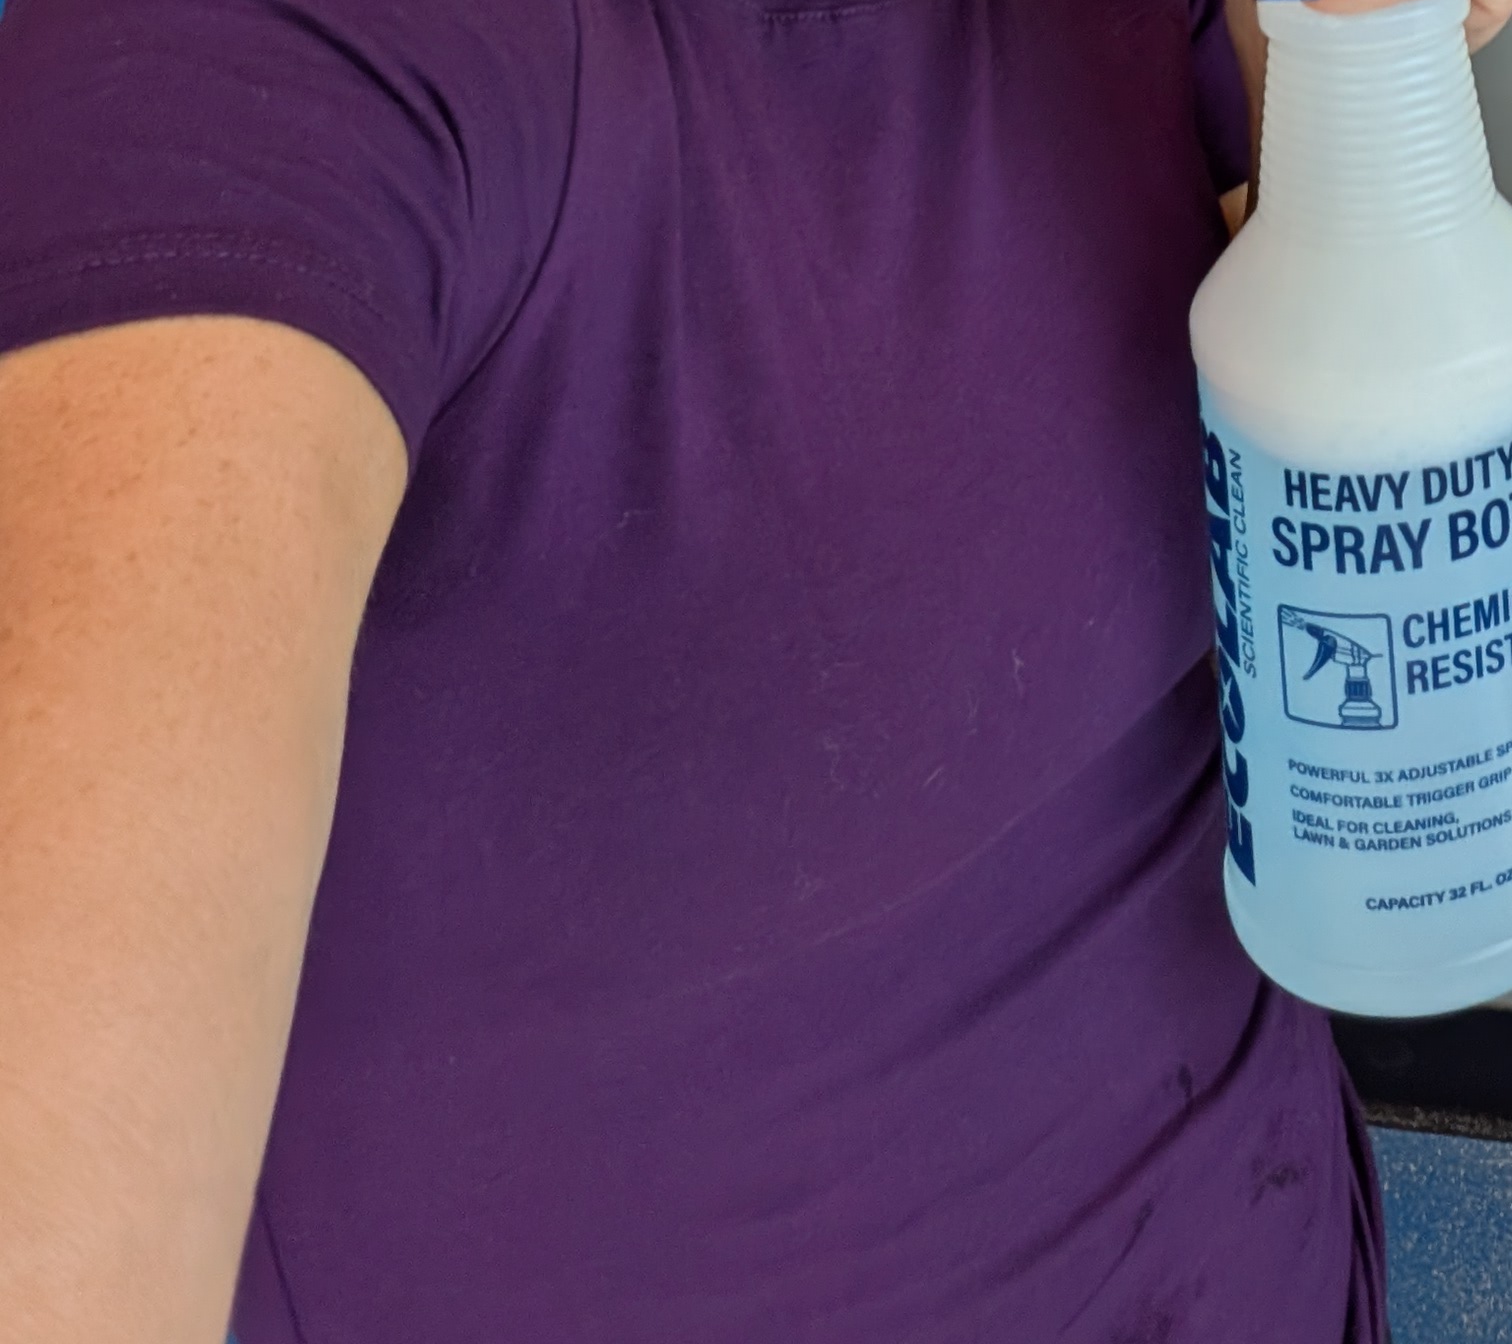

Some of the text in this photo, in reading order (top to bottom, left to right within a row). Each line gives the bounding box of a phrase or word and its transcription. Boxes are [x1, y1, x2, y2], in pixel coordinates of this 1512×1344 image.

[1284, 468, 1410, 512] HEAVY
[1228, 448, 1257, 678] SCIENTIFIC CLEAN
[1272, 516, 1432, 575] SPRAY
[1288, 758, 1371, 784] POWERFUL
[1374, 771, 1394, 783] 3X
[1398, 748, 1494, 782] ADJUSTABLE
[1290, 766, 1512, 809] COMFORTABLE TRIGGER GRIP
[1292, 808, 1459, 834] IDEAL FOR CLEANING,
[1293, 809, 1512, 851] LAWN & GARDEN SOLUTIONS
[1365, 890, 1446, 911] CAPACITY
[1448, 886, 1467, 901] 32
[1470, 880, 1492, 895] FL.
